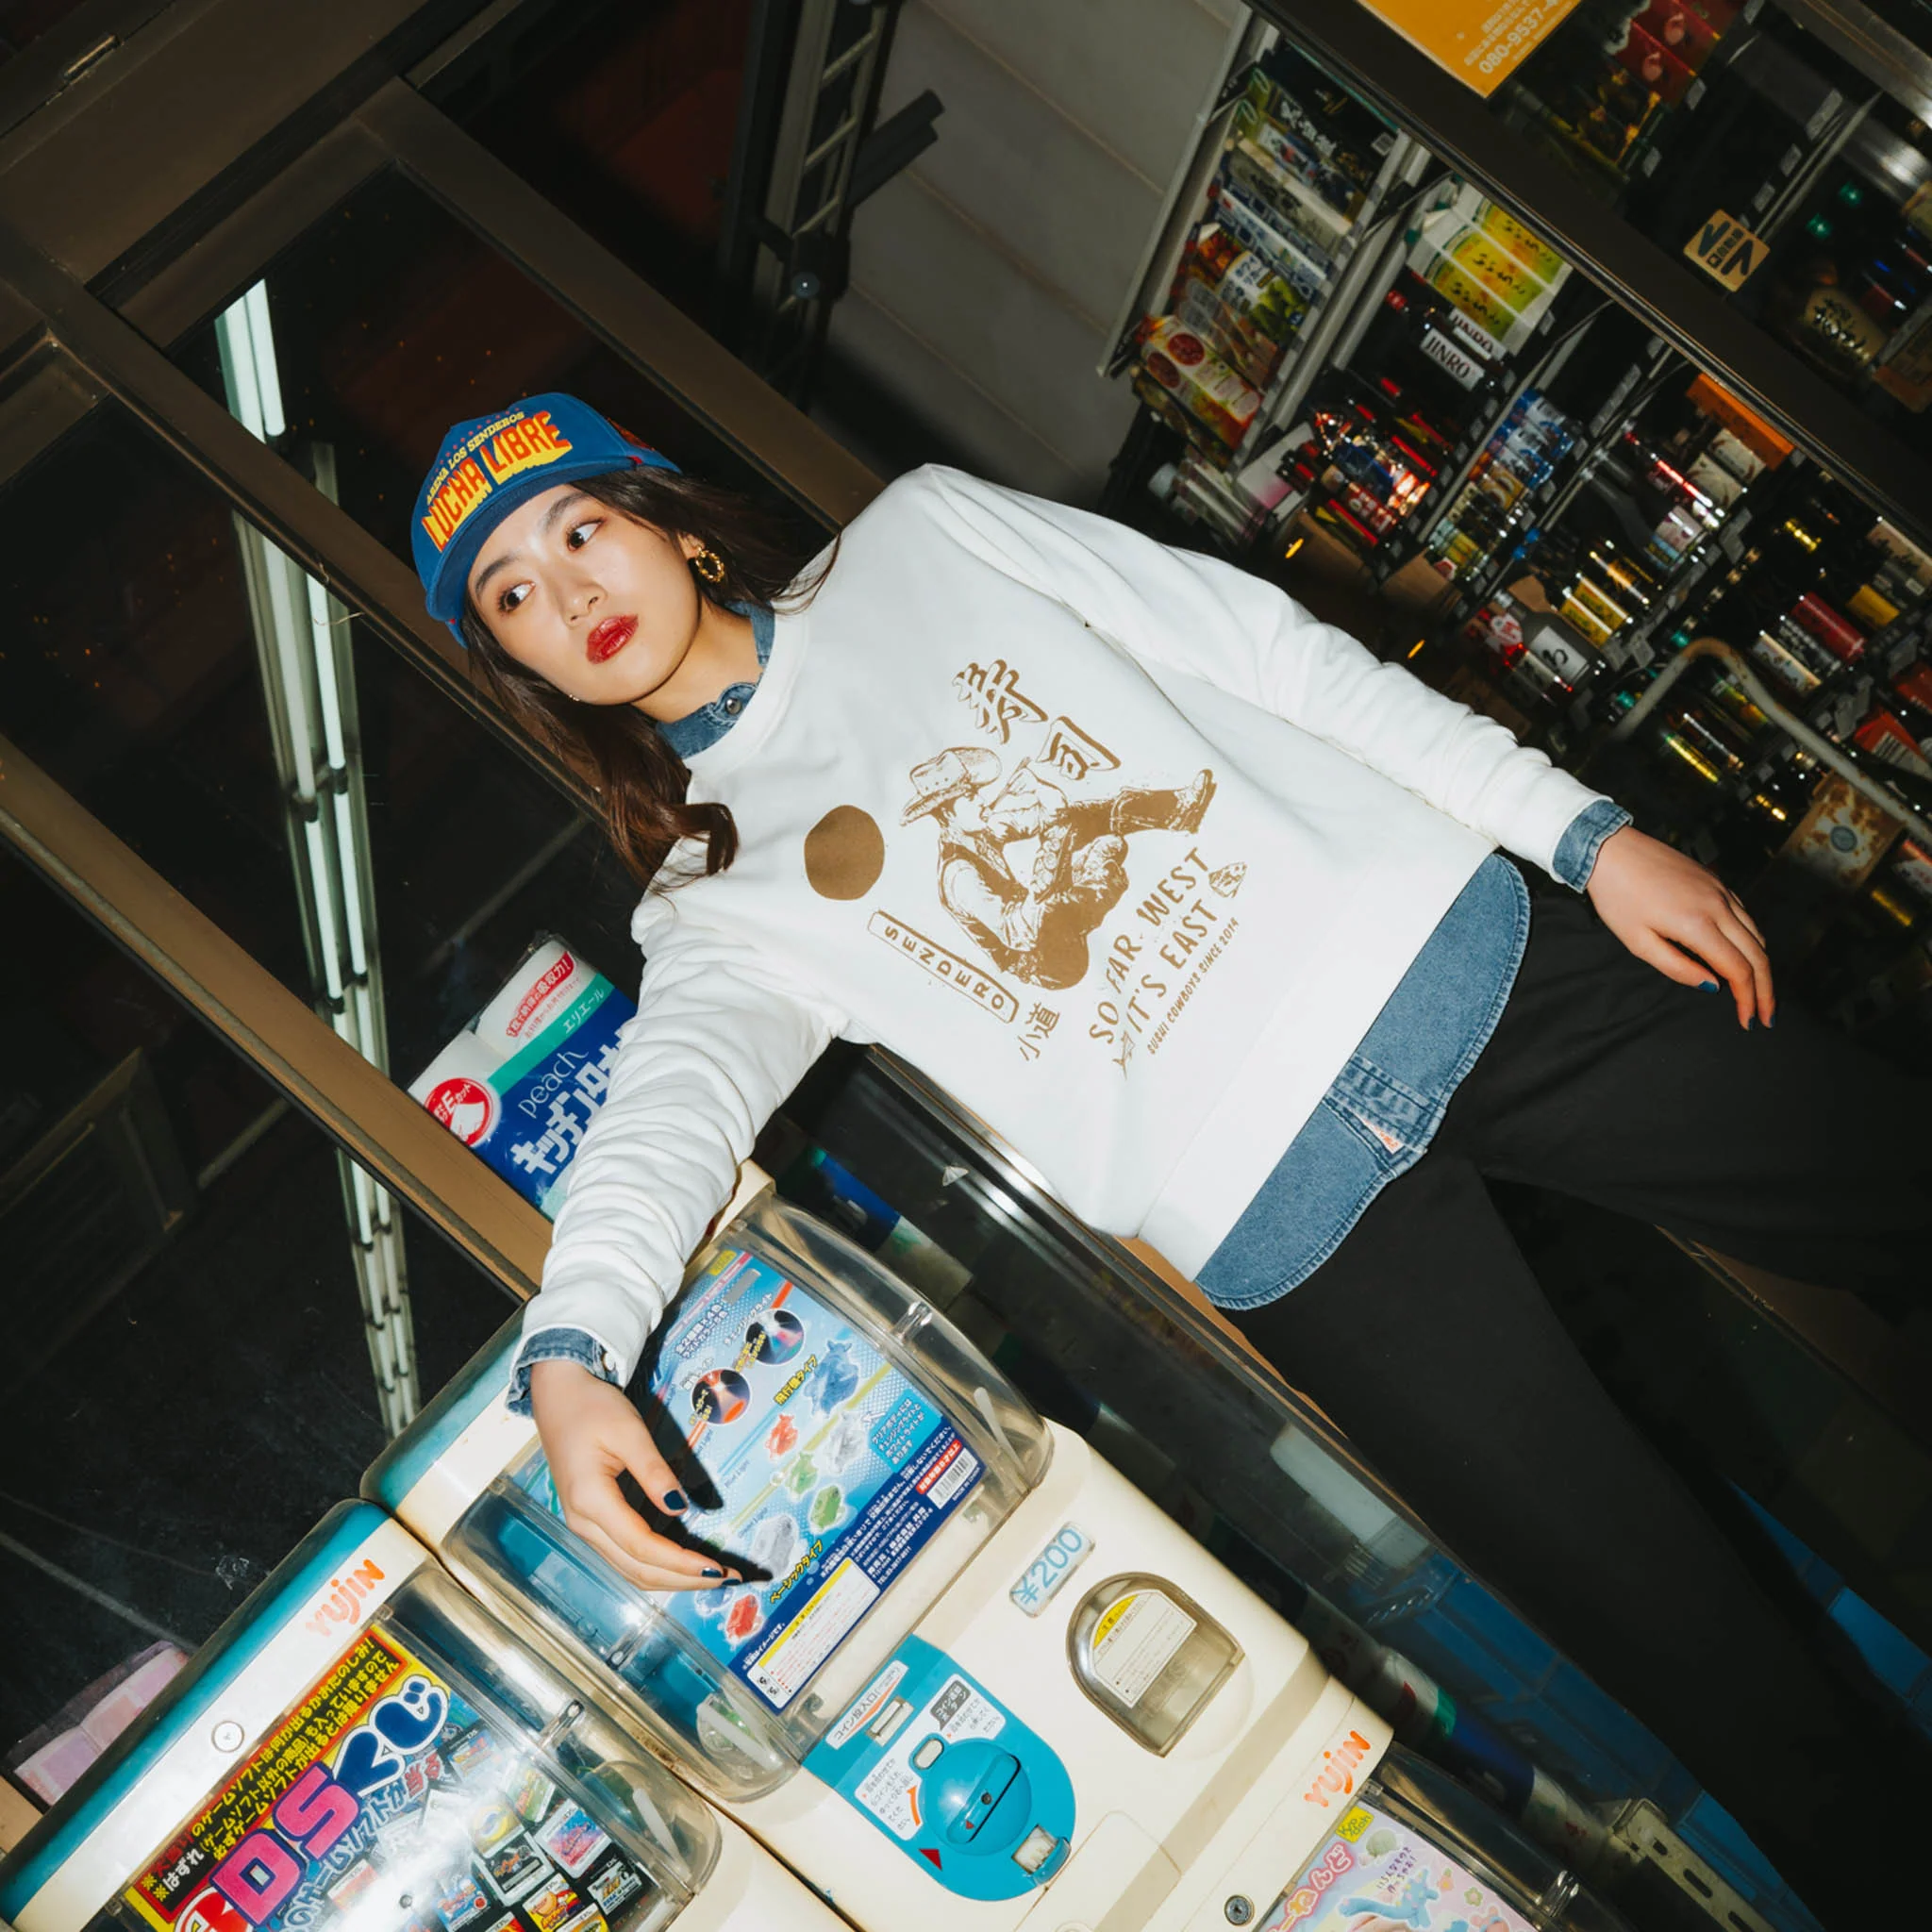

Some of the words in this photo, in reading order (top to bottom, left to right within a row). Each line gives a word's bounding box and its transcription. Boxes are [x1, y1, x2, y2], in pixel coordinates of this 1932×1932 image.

[1424, 334, 1472, 379] JINRO
[447, 446, 468, 470] LOS
[466, 410, 525, 452] SENDEROS
[422, 456, 493, 554] LUCHA
[480, 410, 573, 486] LIBRE
[884, 924, 1006, 1011] SENDERO
[1089, 1000, 1121, 1045] SO
[1106, 933, 1142, 994] FAR
[1135, 846, 1209, 928] WEST
[1159, 898, 1219, 970] EAST
[562, 989, 605, 1033] エリエール
[1018, 1002, 1061, 1062] 小道
[1145, 1022, 1171, 1054] SUSHI
[1165, 971, 1202, 1024] COWBOYS
[1197, 942, 1223, 974] SINCE
[510, 1028, 625, 1174] キッチンタ
[519, 1049, 589, 1119] peach
[773, 1354, 822, 1407] 飛行機タイプ
[768, 1538, 826, 1607] ベーシックタイプ
[1010, 1524, 1087, 1609] ¥200
[833, 1690, 878, 1741] コイン投入口
